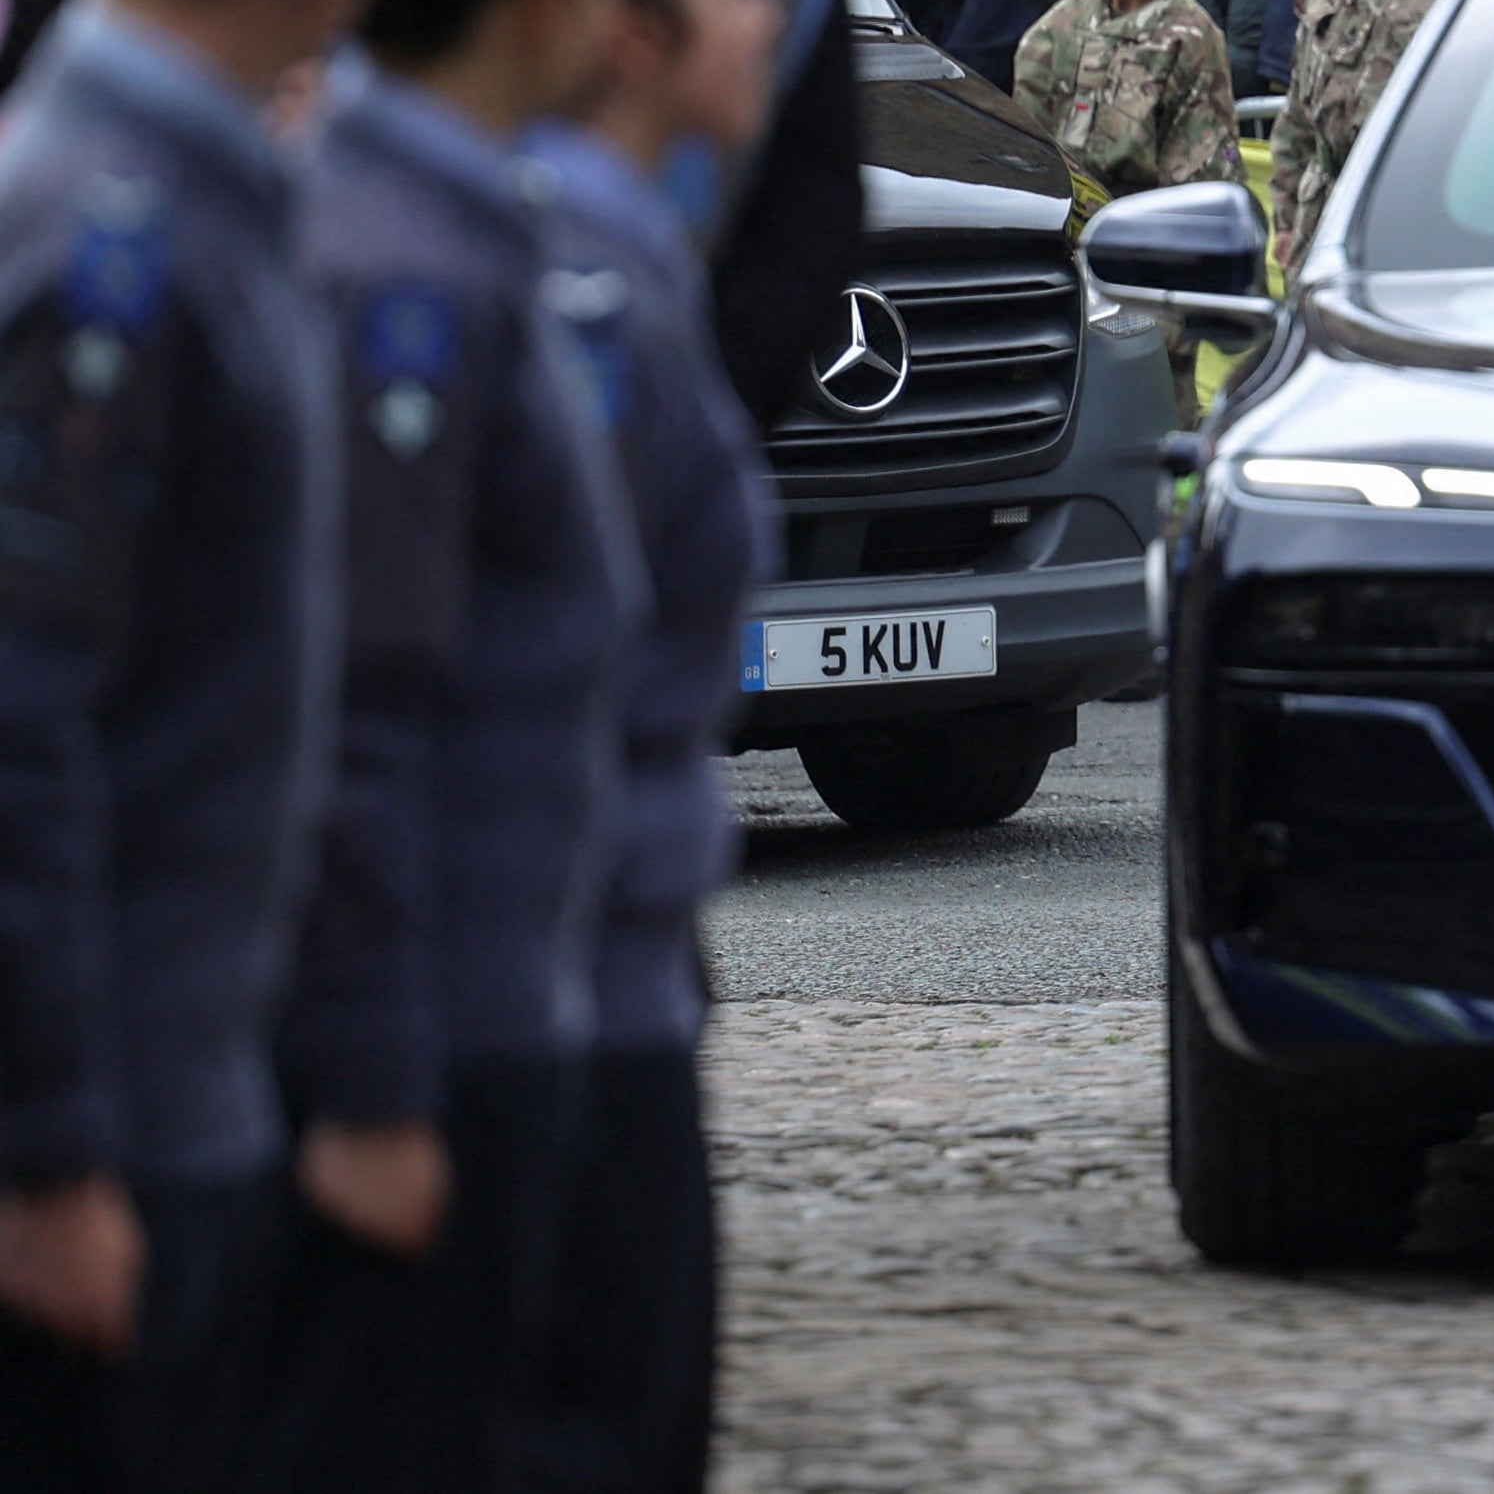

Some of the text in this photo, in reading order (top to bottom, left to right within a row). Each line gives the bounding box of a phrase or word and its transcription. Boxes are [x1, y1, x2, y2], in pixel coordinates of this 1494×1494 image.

[821, 619, 946, 677] 5 KUV
[744, 665, 761, 680] GB
